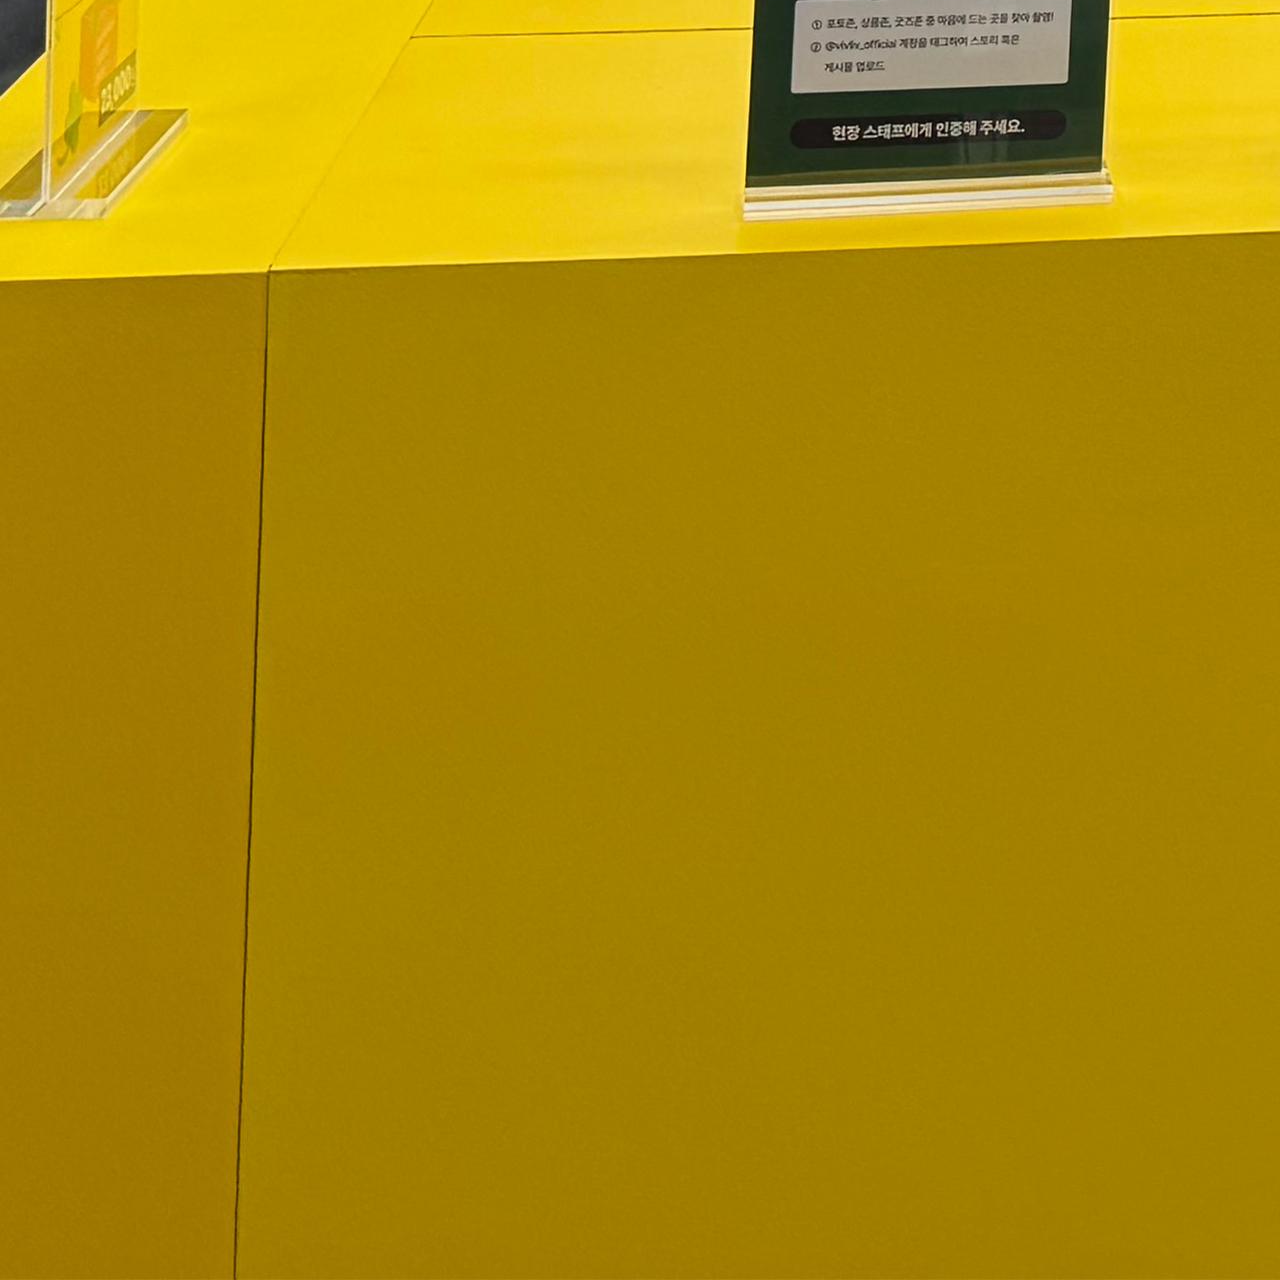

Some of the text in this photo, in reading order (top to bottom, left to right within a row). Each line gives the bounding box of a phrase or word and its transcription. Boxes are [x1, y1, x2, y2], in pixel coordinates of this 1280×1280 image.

[937, 14, 967, 27] 마음에
[968, 14, 987, 26] 드는
[970, 35, 999, 47] 스토리
[856, 61, 885, 72] 업로드
[832, 119, 1025, 141] 현장 스태프에게 인증해 주세요.
